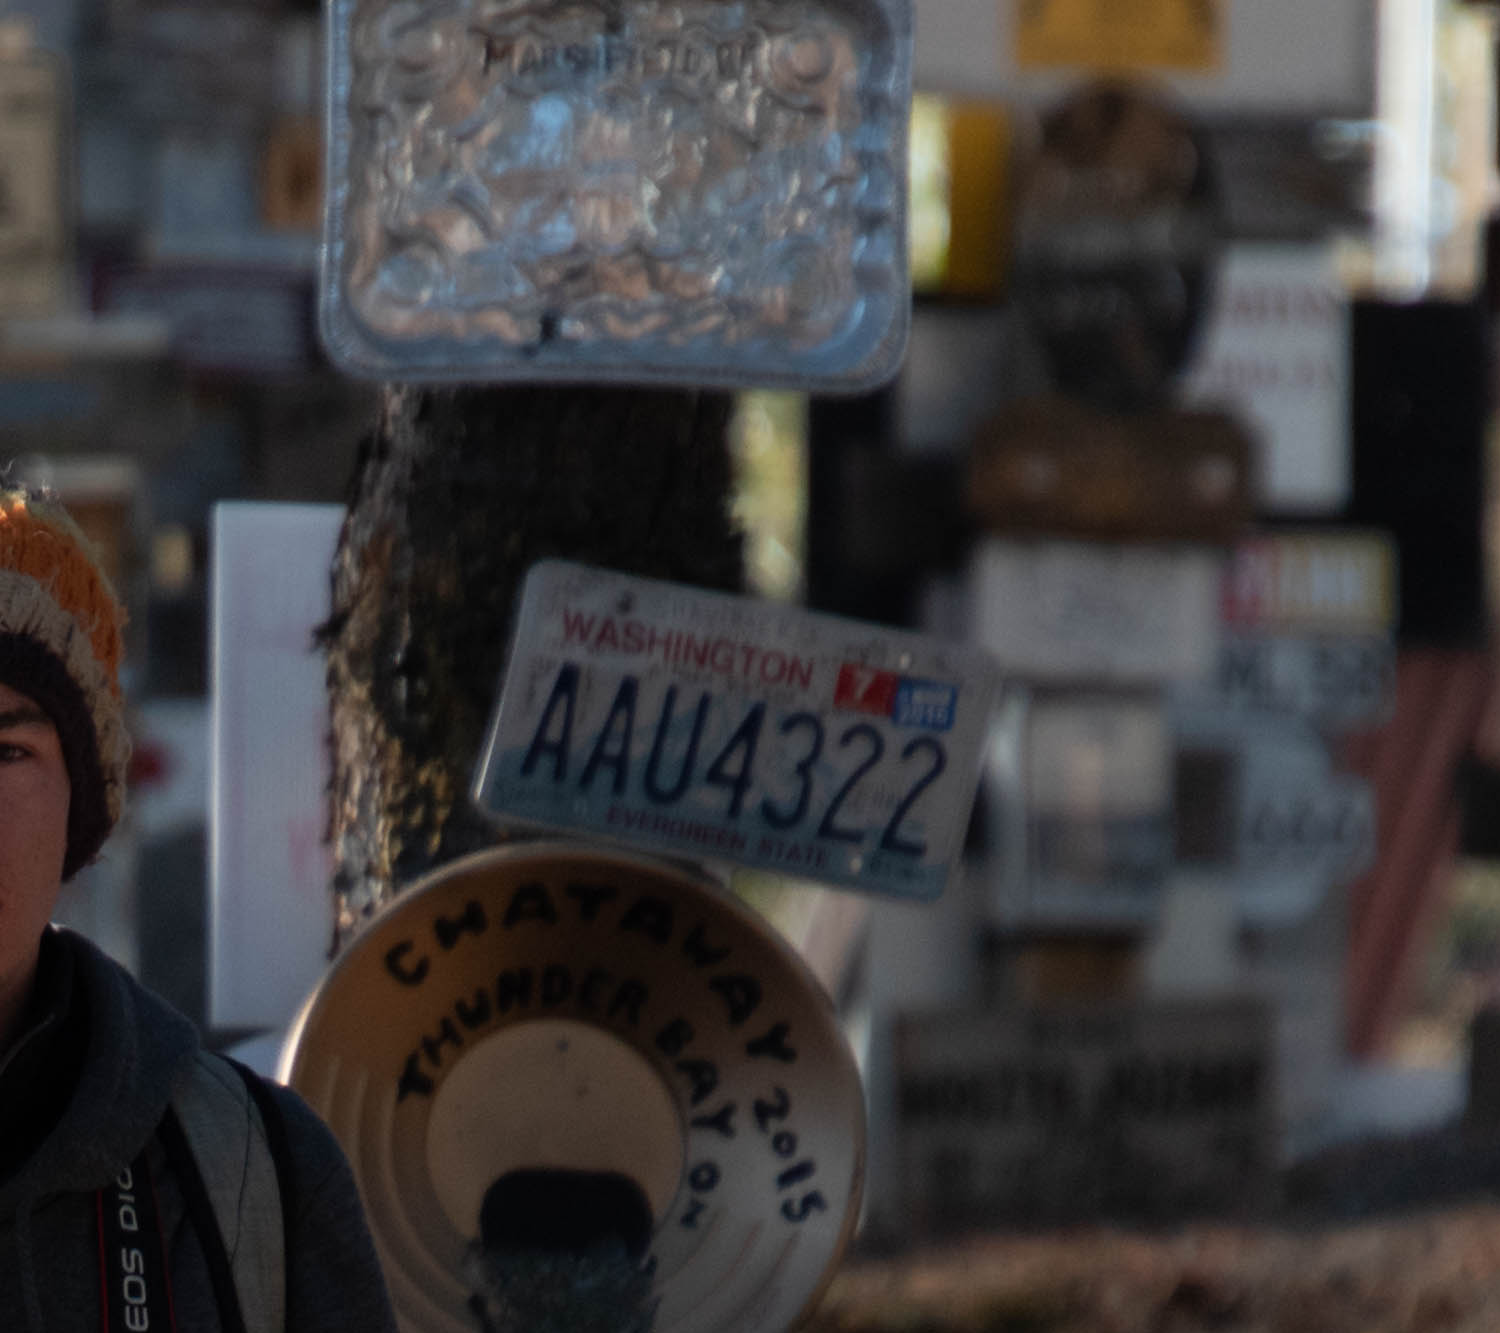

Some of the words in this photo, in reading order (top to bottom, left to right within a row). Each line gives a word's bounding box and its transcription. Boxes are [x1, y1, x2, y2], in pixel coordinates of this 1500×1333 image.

[561, 607, 816, 692] WASHINGTON
[519, 660, 949, 859] AAU4322
[605, 805, 747, 852] EVERGREEN
[385, 883, 797, 1067] CHATAWAY
[398, 966, 645, 1106] THUNDER
[651, 1012, 738, 1142] BAY
[120, 1247, 150, 1333] EOS
